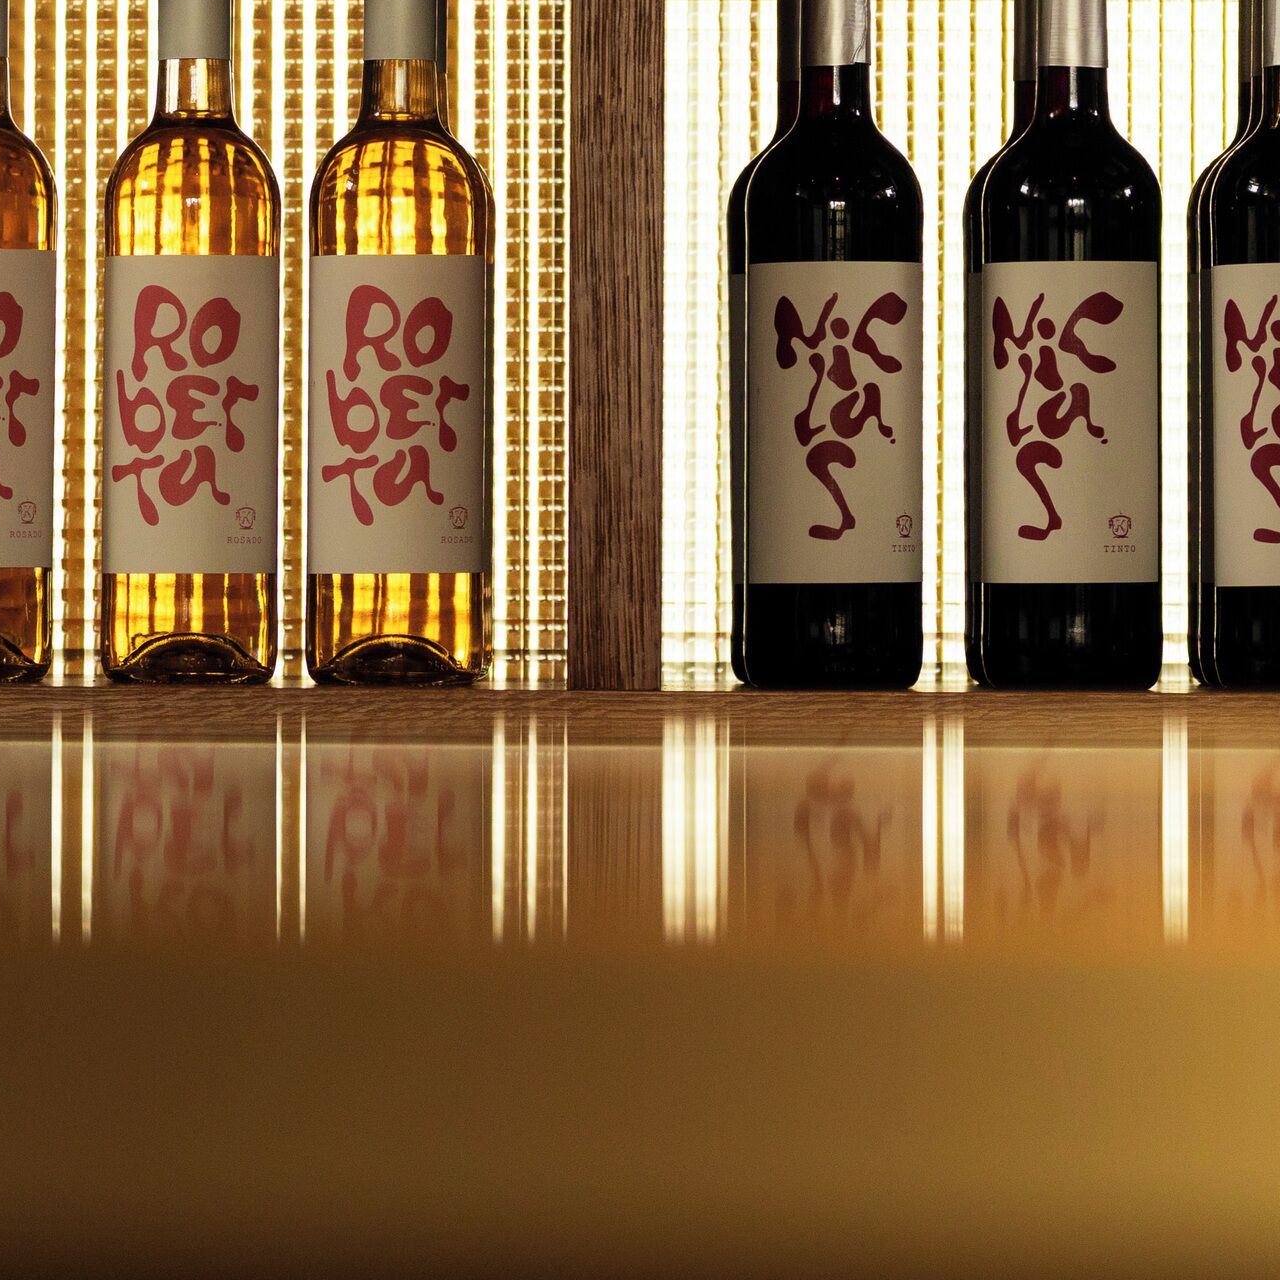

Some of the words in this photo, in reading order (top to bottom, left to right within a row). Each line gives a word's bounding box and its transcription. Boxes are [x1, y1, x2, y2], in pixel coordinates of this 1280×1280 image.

[9, 530, 43, 540] ROSADO
[226, 536, 263, 546] ROSADO
[440, 536, 474, 545] ROSADO
[891, 544, 917, 554] TINTO
[1103, 544, 1137, 554] TINTO
